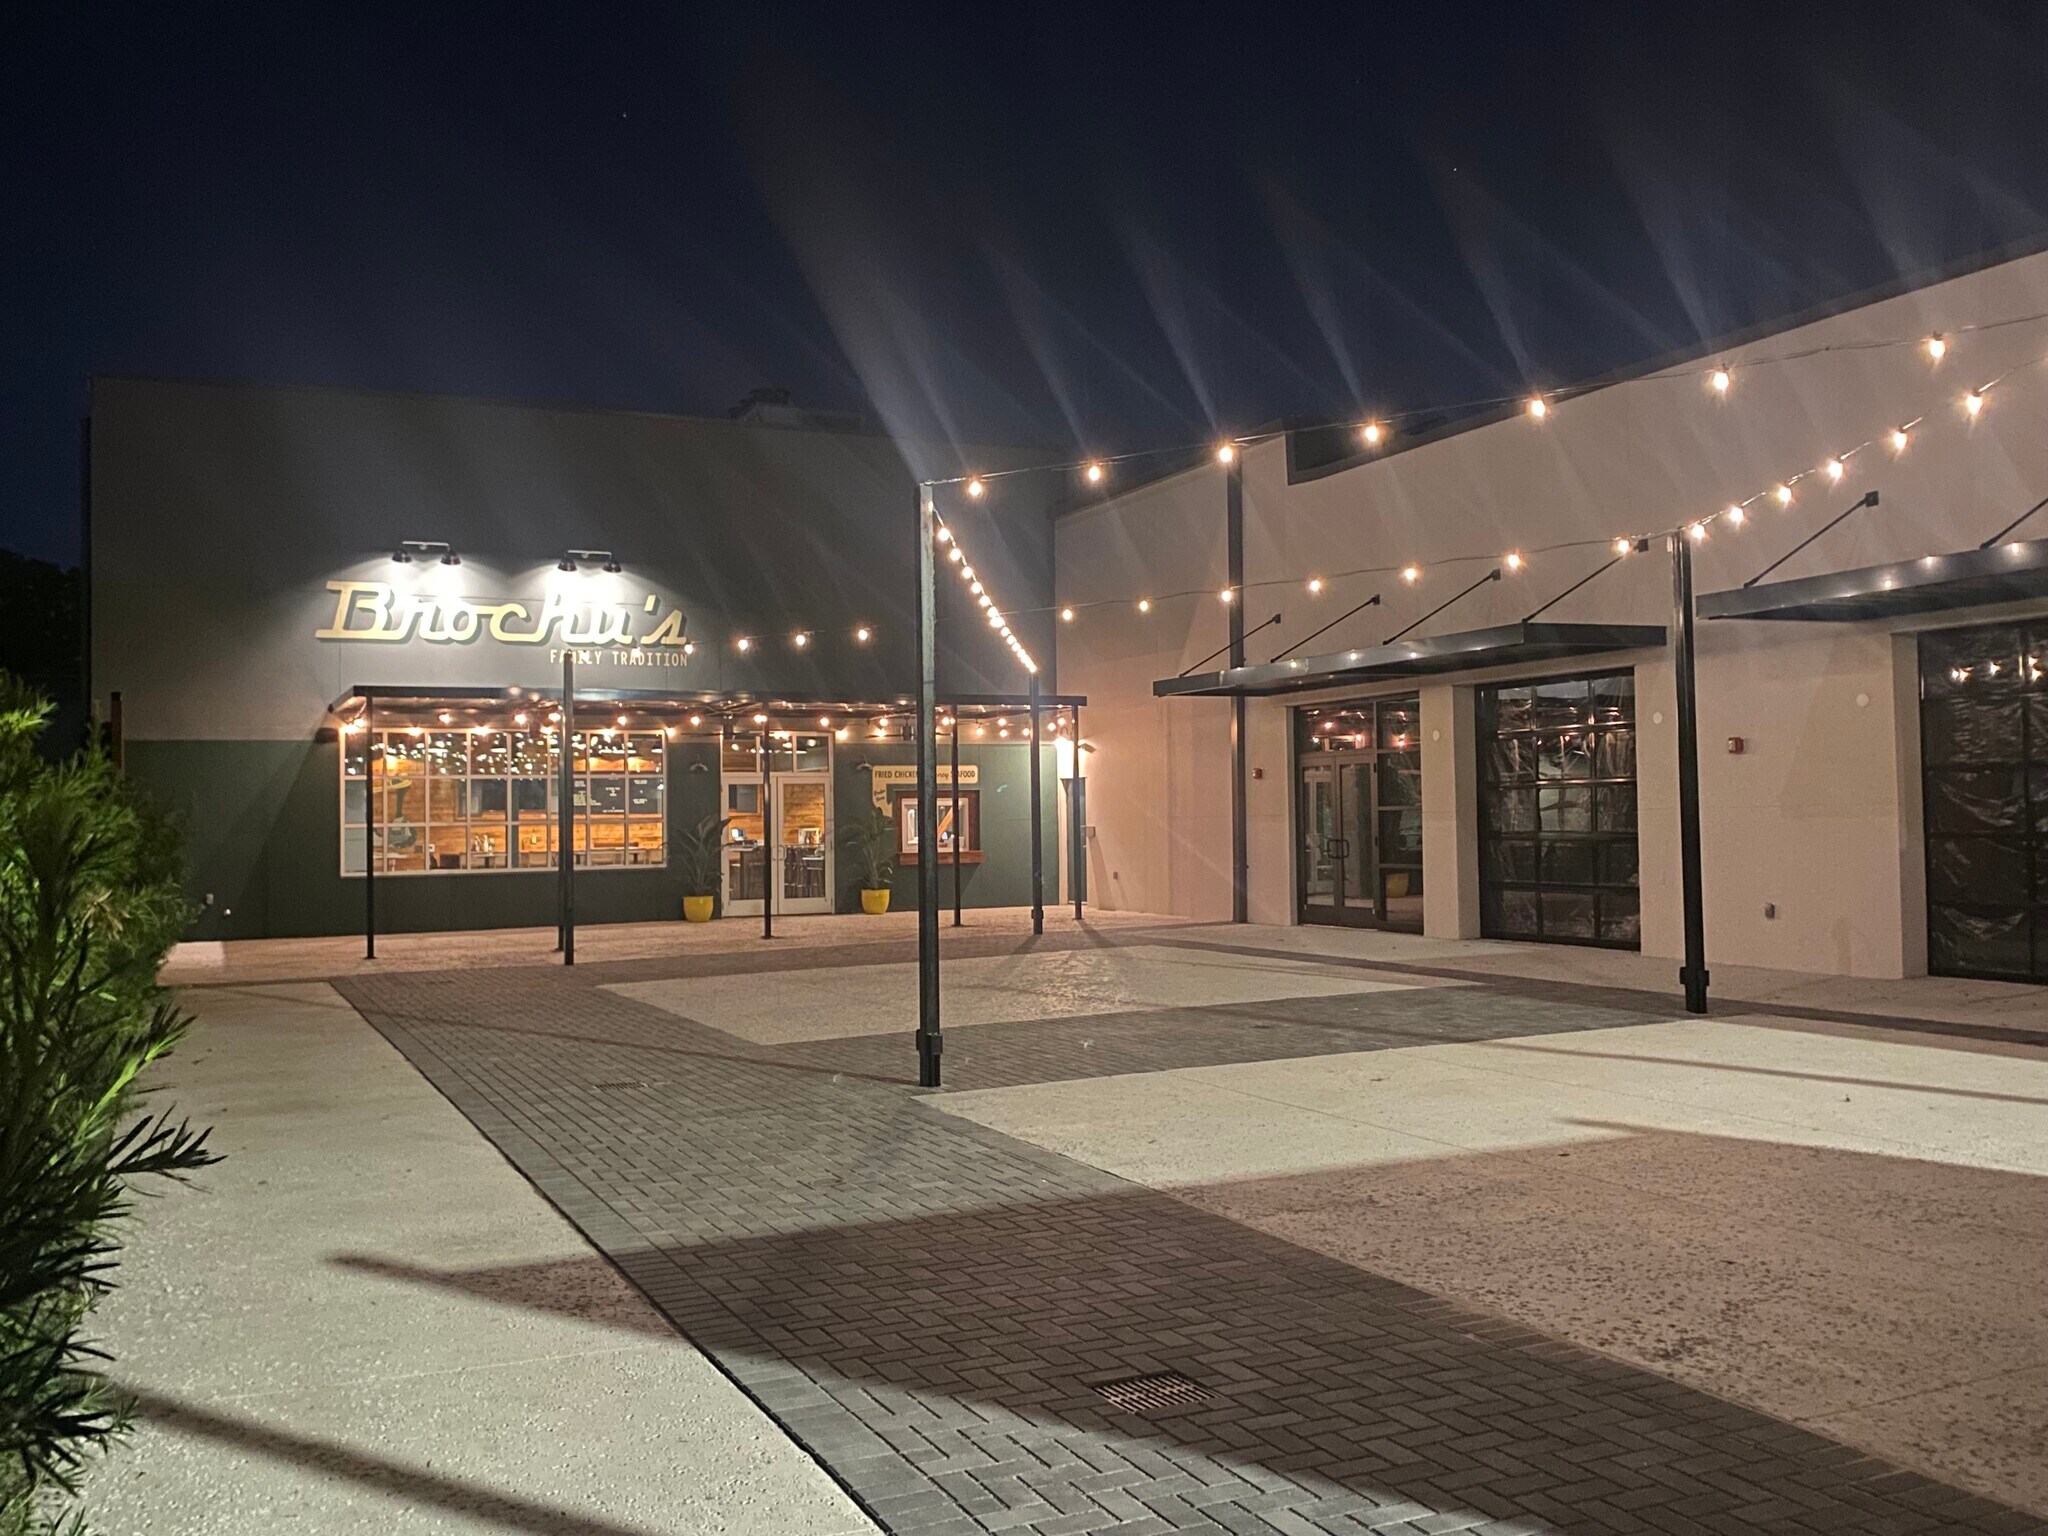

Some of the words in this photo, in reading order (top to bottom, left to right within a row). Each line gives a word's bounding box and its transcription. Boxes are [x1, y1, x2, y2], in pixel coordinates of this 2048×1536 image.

[315, 580, 688, 645] Brochu's
[612, 651, 688, 667] TRADITION
[874, 770, 892, 778] FRIED
[894, 770, 918, 778] CHICKE
